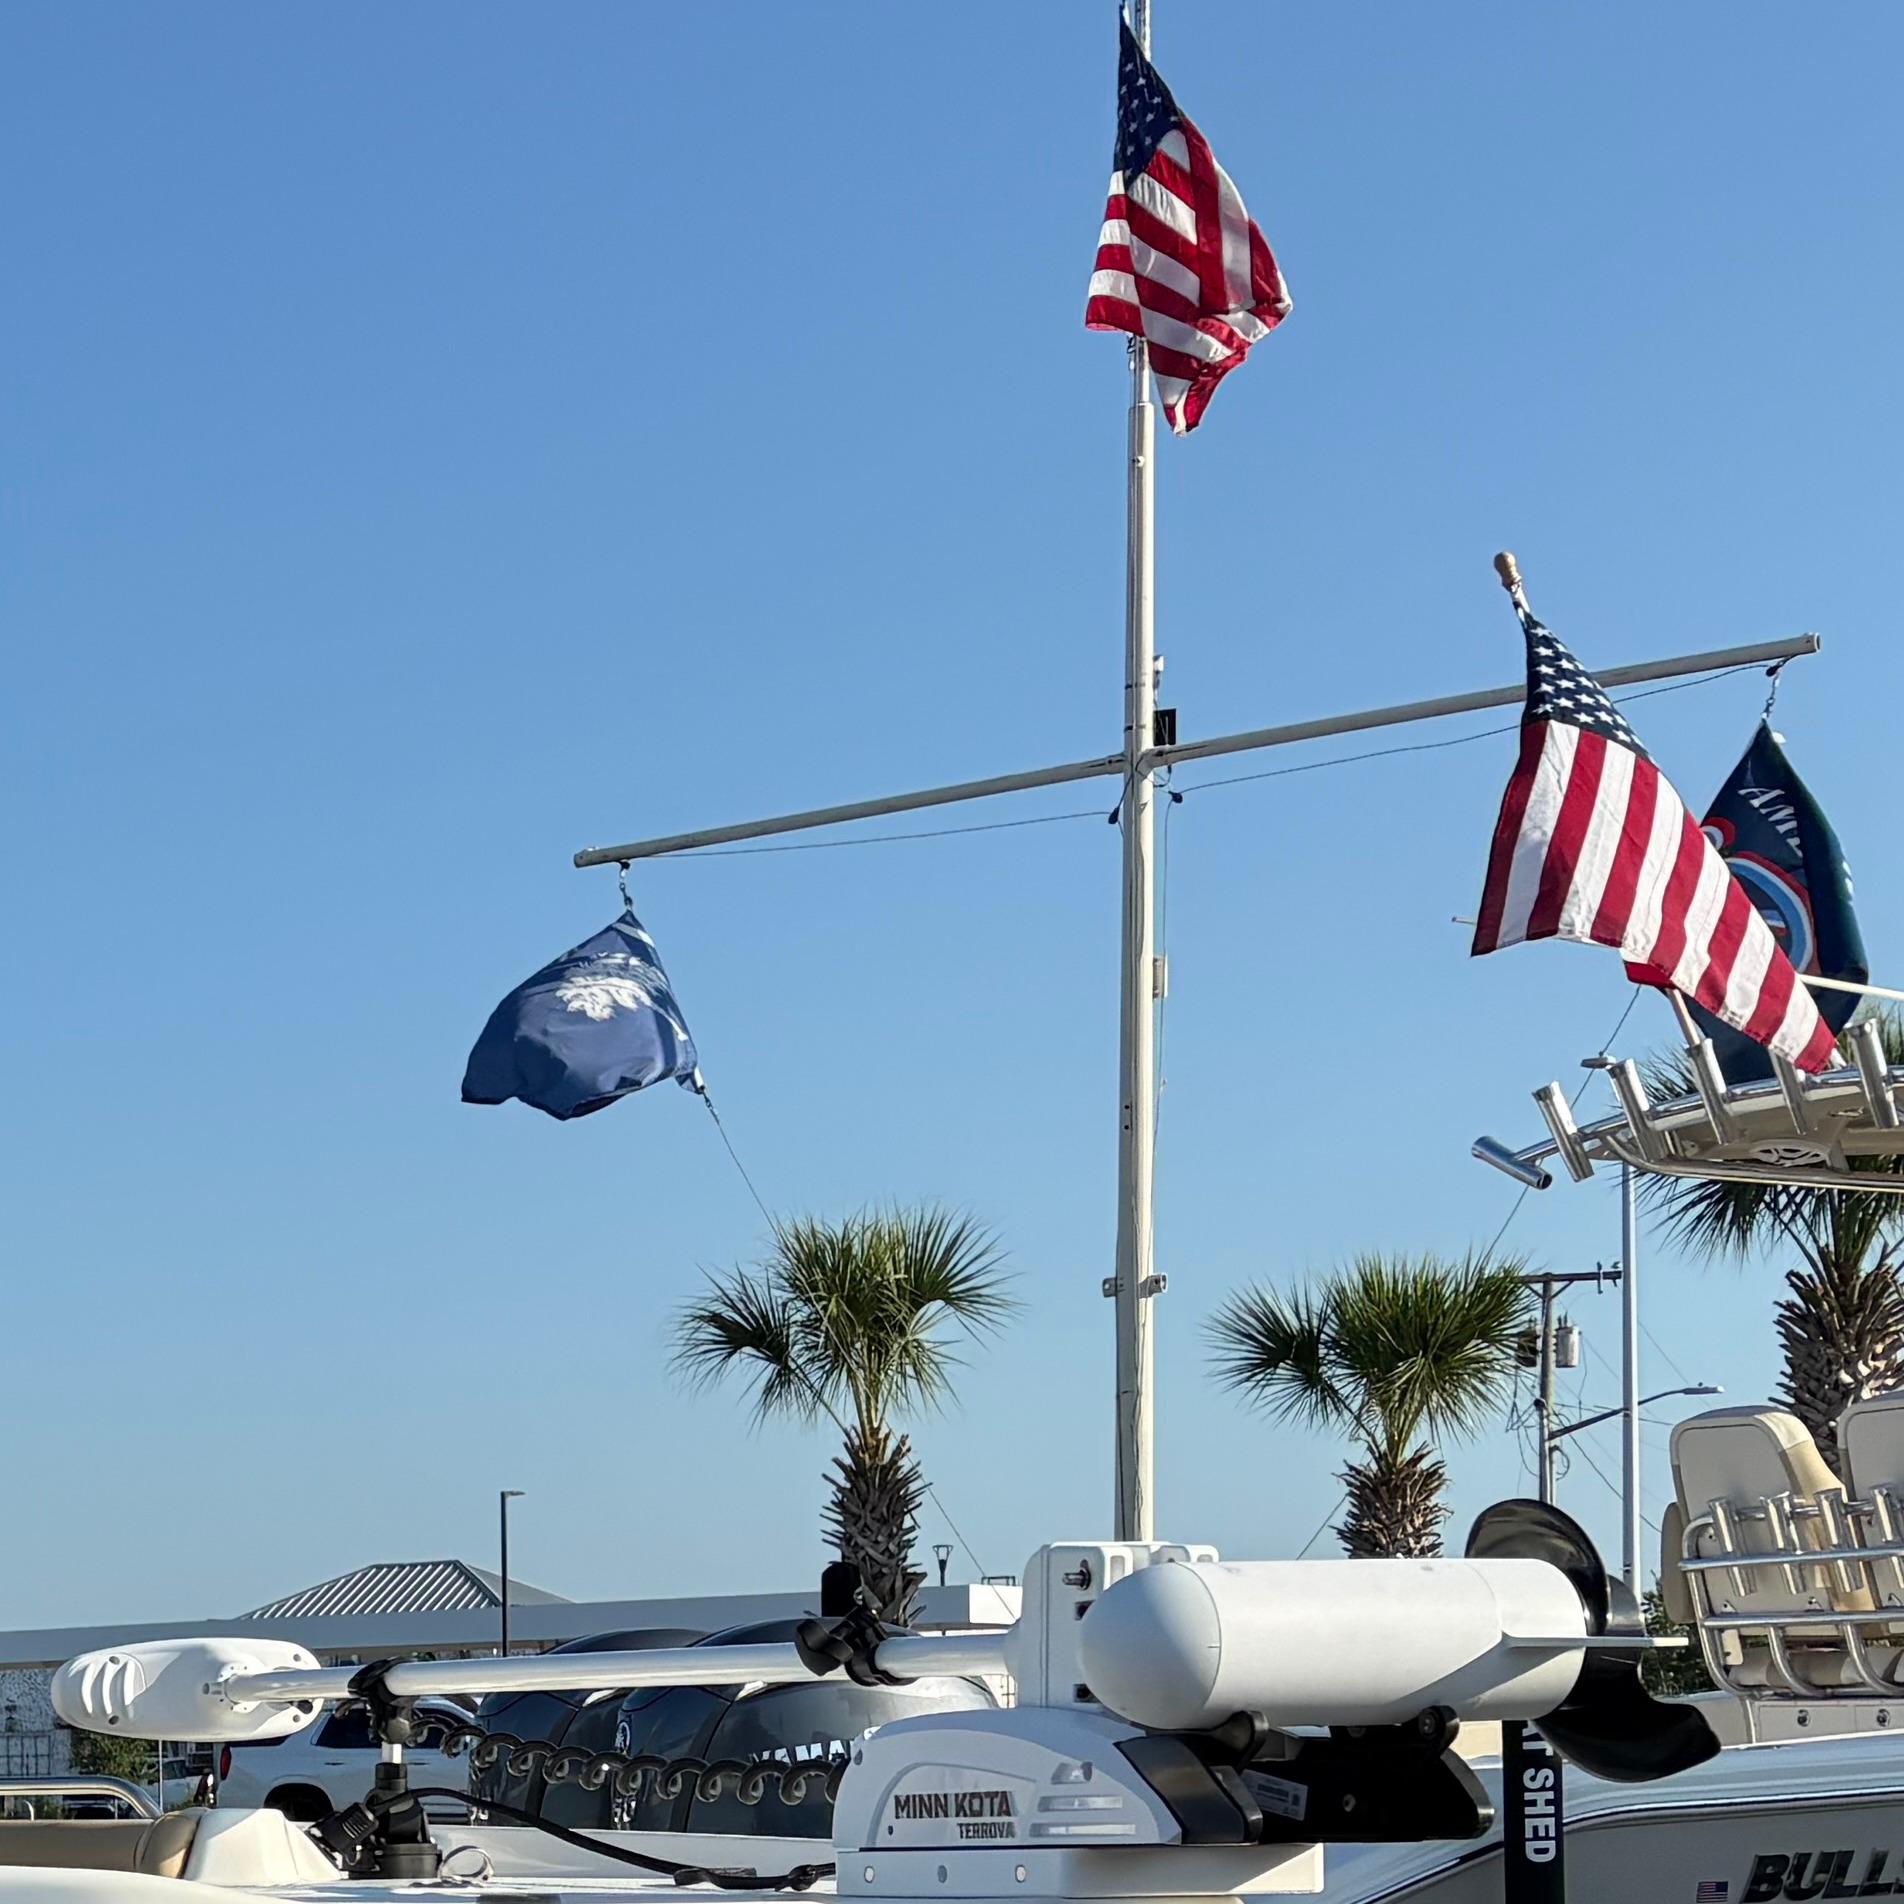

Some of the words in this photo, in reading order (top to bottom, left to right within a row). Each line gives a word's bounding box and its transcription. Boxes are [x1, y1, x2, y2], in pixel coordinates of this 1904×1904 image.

[894, 1793, 948, 1819] MINN
[955, 1791, 1012, 1817] KOTA
[1523, 1768, 1556, 1863] SHED
[957, 1822, 1016, 1839] TERROVA
[1739, 1849, 1904, 1904] BULL
